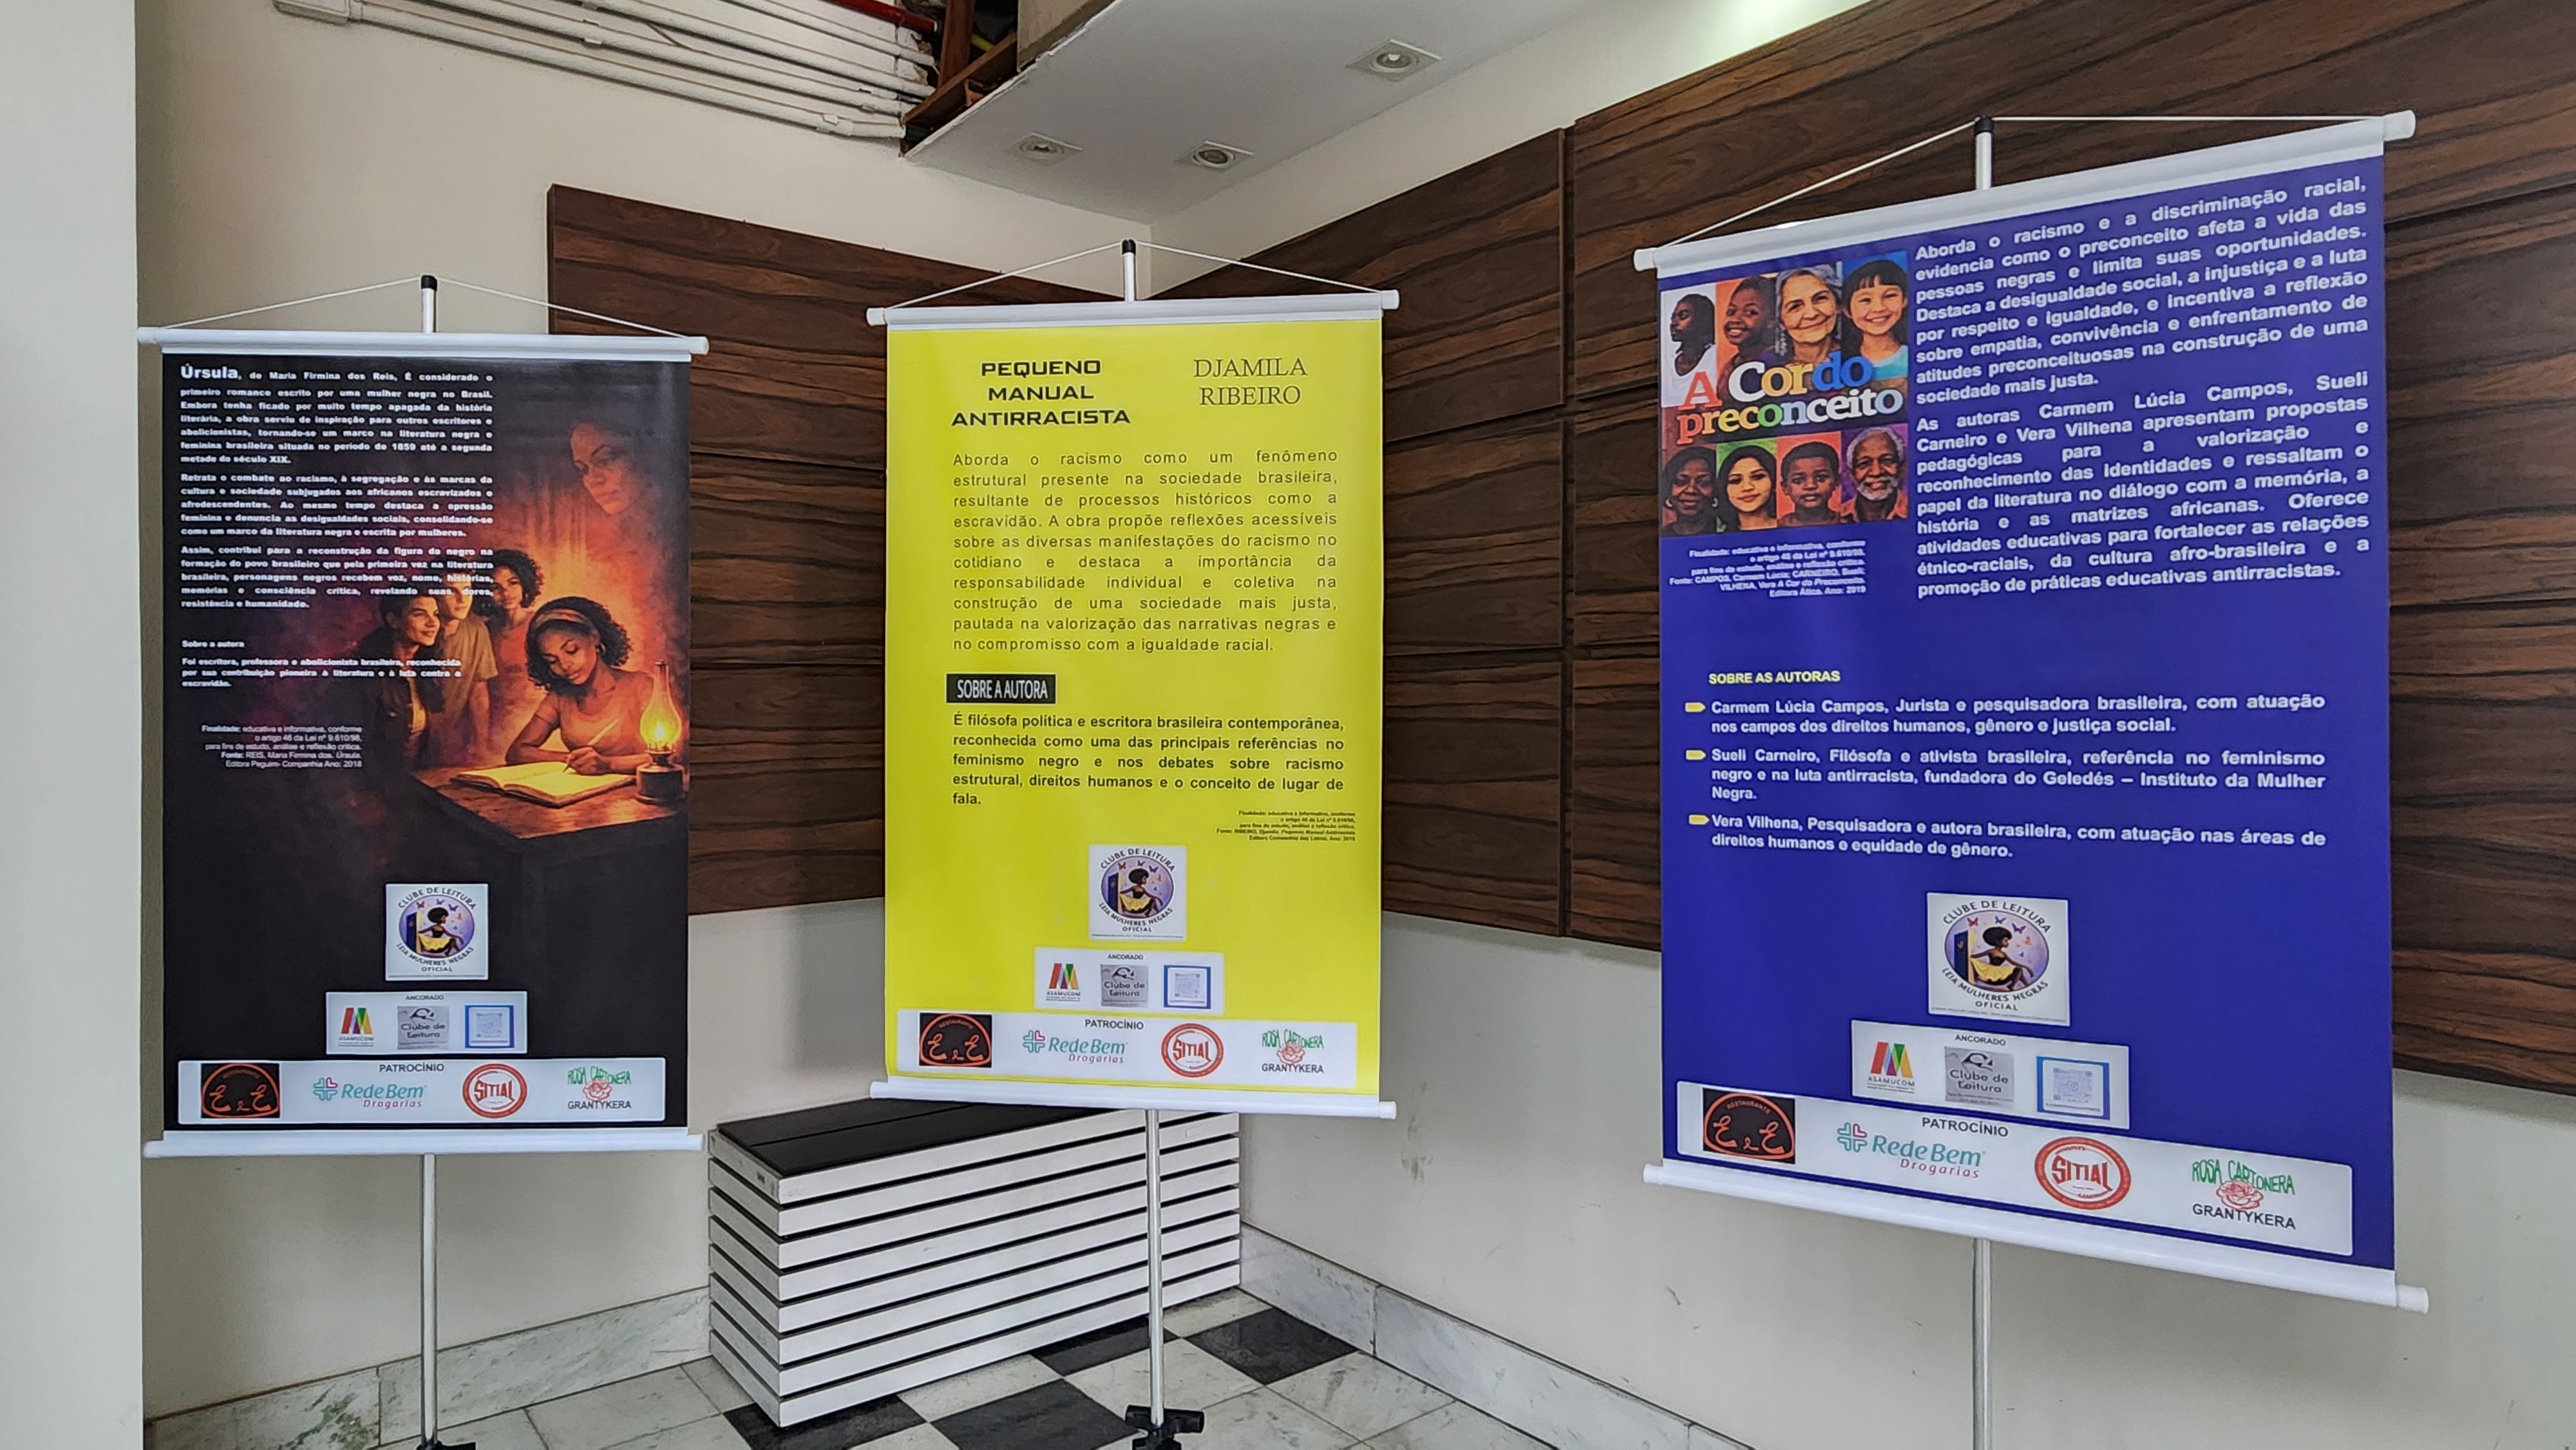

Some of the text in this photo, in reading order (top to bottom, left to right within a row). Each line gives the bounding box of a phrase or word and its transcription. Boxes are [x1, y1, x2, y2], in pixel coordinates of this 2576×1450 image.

[1915, 175, 2366, 260] Aborda o racismo e a discriminação racial,
[981, 360, 1101, 378] PEQUENO
[1193, 357, 1308, 377] DJAMILA
[269, 372, 297, 380] Maria
[303, 372, 341, 380] Firmina
[372, 372, 398, 381] Reis,
[404, 372, 412, 381] É
[419, 373, 479, 381] considerado
[1678, 352, 1873, 410] A Cor do
[180, 388, 221, 397] primeiro
[366, 389, 402, 398] mulher
[461, 390, 493, 399] Brasil.
[989, 385, 1094, 401] MANUAL
[1199, 386, 1301, 406] RIBEIRO
[1917, 372, 2099, 404] sociedade mais justa.
[1917, 371, 2368, 431] As autoras Carmem Lúcia Campos, Sueli
[951, 410, 1131, 426] ANTIRRACISTA
[1676, 388, 1904, 445] preconceito
[233, 455, 268, 463] século
[269, 455, 291, 464] XIX.
[953, 449, 1337, 466] Aborda o racismo como um fenômeno
[953, 470, 1337, 489] estrutural presente na sociedade brasileira,
[954, 511, 1337, 530] escravidão. A obra propõe reflexões acessíveis
[1918, 563, 2340, 599] promoção de práticas educativas antirracistas.
[953, 596, 1336, 612] construção de uma sociedade mais justa,
[1709, 670, 1841, 684] SOBRE AS AUTORAS
[957, 679, 1048, 699] SOBRE A AUTORA
[1711, 693, 2325, 715] Carmem Lúcia Campos, Jurista e pesquisadora brasileira, com atuação
[954, 713, 1343, 732] É filósofa política e escritora brasileira contemporânea,
[952, 792, 981, 805] fala.
[1712, 786, 1757, 802] Negra.
[1101, 849, 1125, 869] CLUBE
[1142, 849, 1175, 871] LEITURA
[1099, 903, 1173, 926] LEIA MULHERES NEGRAS
[1943, 901, 1978, 924] CLUBE
[2003, 902, 2051, 933] LEITURA
[1942, 968, 2049, 1001] LEIA MULHERES NEGRAS
[1975, 1001, 2018, 1011] OFICIAL
[1084, 1019, 1144, 1030] PATROCÍNIO
[1262, 1030, 1281, 1046] ROSA
[1955, 1034, 2006, 1046] ANCORADO
[1068, 1053, 1124, 1064] Drogarias
[1172, 1037, 1209, 1062] SITIAL
[379, 1062, 444, 1073] PATROCÍNIO
[1261, 1062, 1324, 1073] GRANTYKERA
[1950, 1069, 2009, 1084] Clube de
[1868, 1076, 1915, 1087] ASAMUCOM
[1958, 1081, 2002, 1093] Leitura
[475, 1080, 514, 1104] SITIAL
[363, 1098, 422, 1109] Drogarias
[567, 1100, 632, 1110] GRANTYKERA
[1726, 1101, 1770, 1115] RESTAURANTE
[1922, 1116, 2009, 1137] PATROCÍNIO
[1900, 1158, 1980, 1179] Drogarias
[2051, 1155, 2112, 1191] SITIAL
[2192, 1160, 2222, 1184] ROSA
[2192, 1203, 2296, 1230] GRANTYKERA
